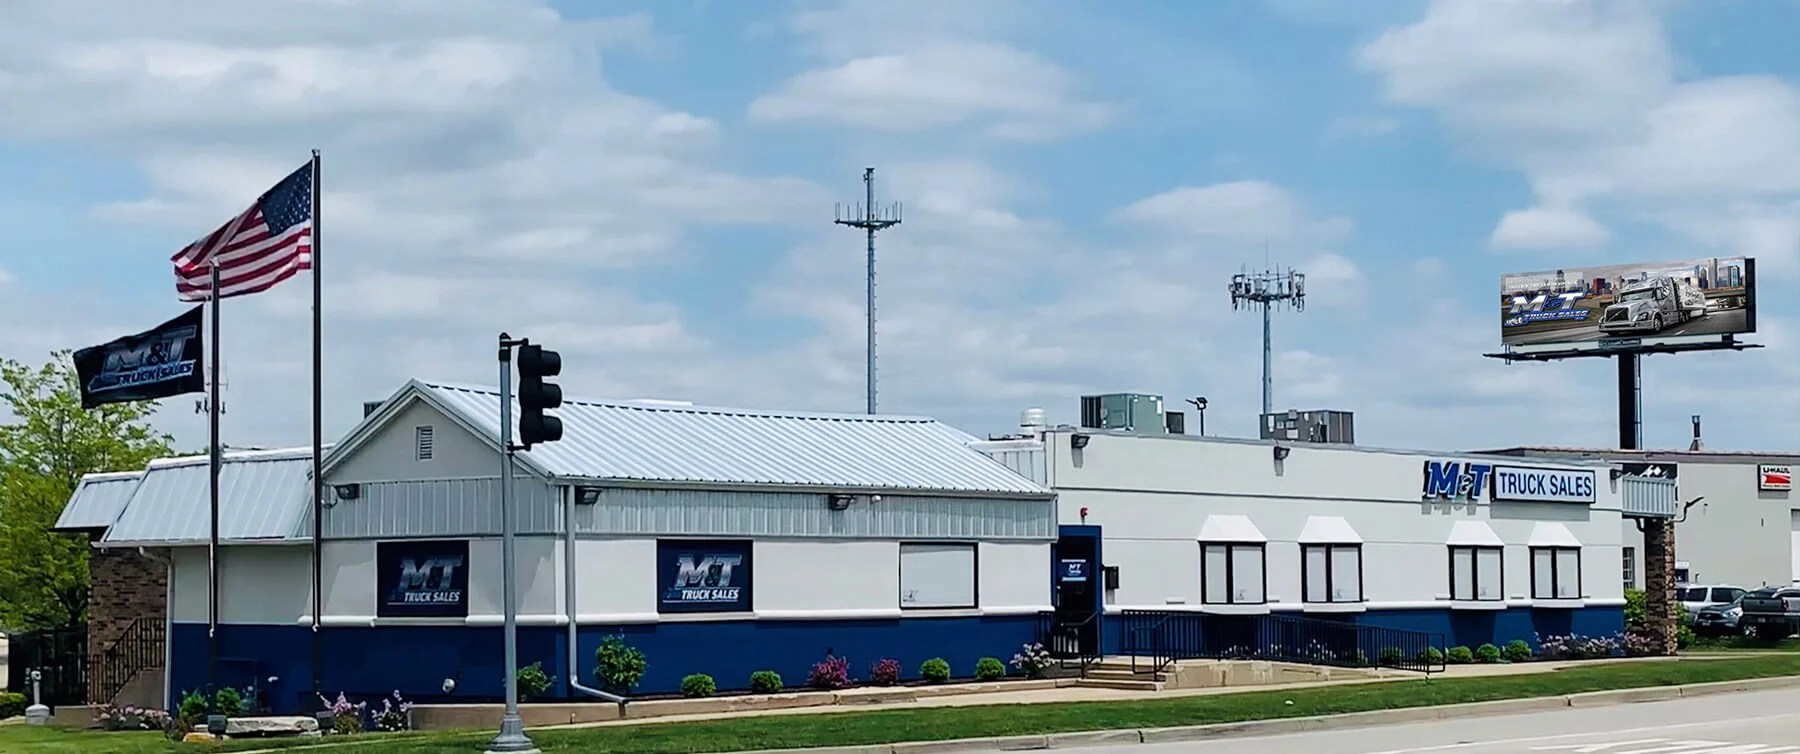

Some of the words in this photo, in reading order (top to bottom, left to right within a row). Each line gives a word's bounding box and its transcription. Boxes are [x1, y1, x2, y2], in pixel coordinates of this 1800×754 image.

[1524, 312, 1557, 321] TRUCK
[1558, 310, 1589, 319] SALES
[100, 324, 197, 374] M&T
[1423, 460, 1493, 499] M&T
[1499, 472, 1546, 495] TRUCK
[1549, 475, 1592, 497] SALES
[674, 553, 743, 590] M&T
[405, 592, 432, 602] TRUCK
[432, 591, 460, 602] SALES
[682, 590, 710, 600] TRUCK
[711, 589, 739, 600] SALES
